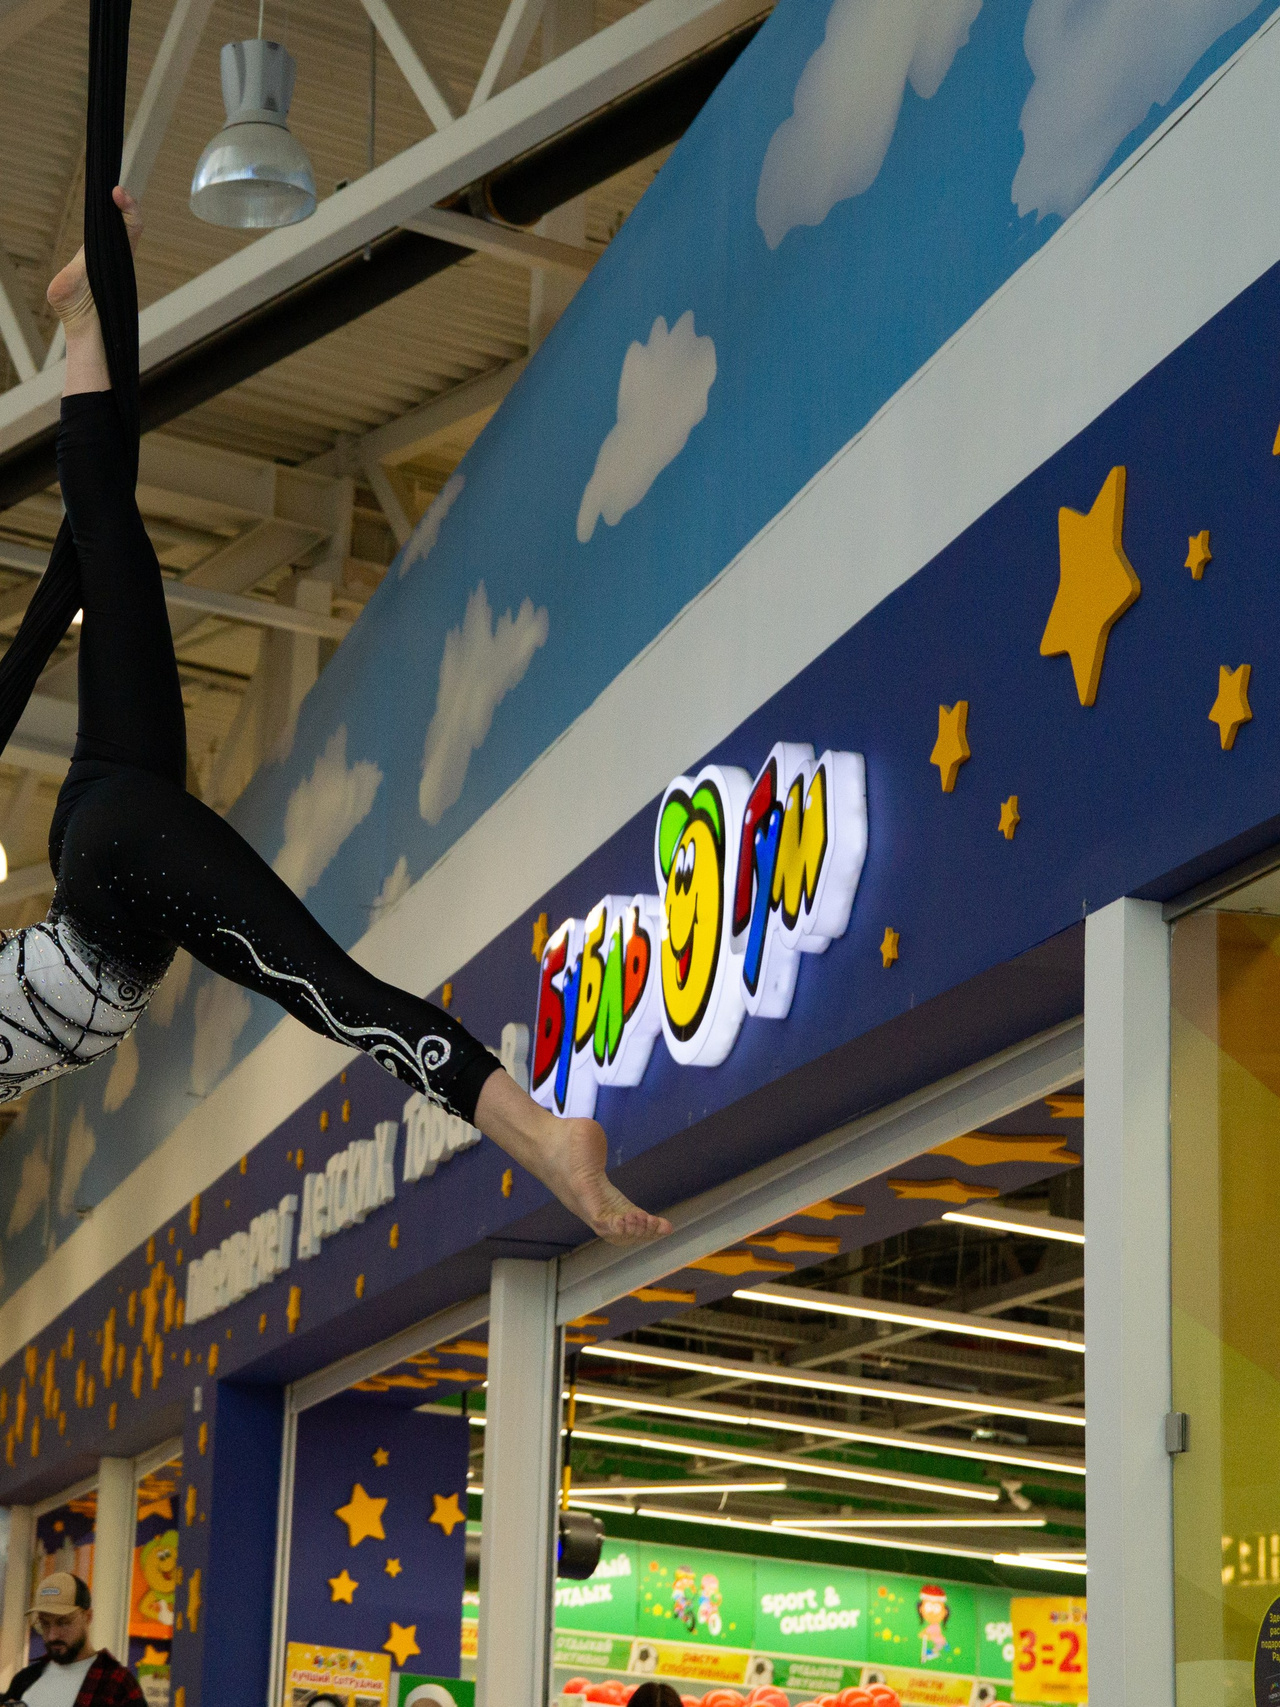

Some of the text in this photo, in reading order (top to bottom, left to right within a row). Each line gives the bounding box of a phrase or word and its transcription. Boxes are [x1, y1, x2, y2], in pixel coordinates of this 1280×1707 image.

[761, 1585, 841, 1618] sport &
[780, 1608, 861, 1635] outdoor
[1018, 1630, 1082, 1672] 3=2
